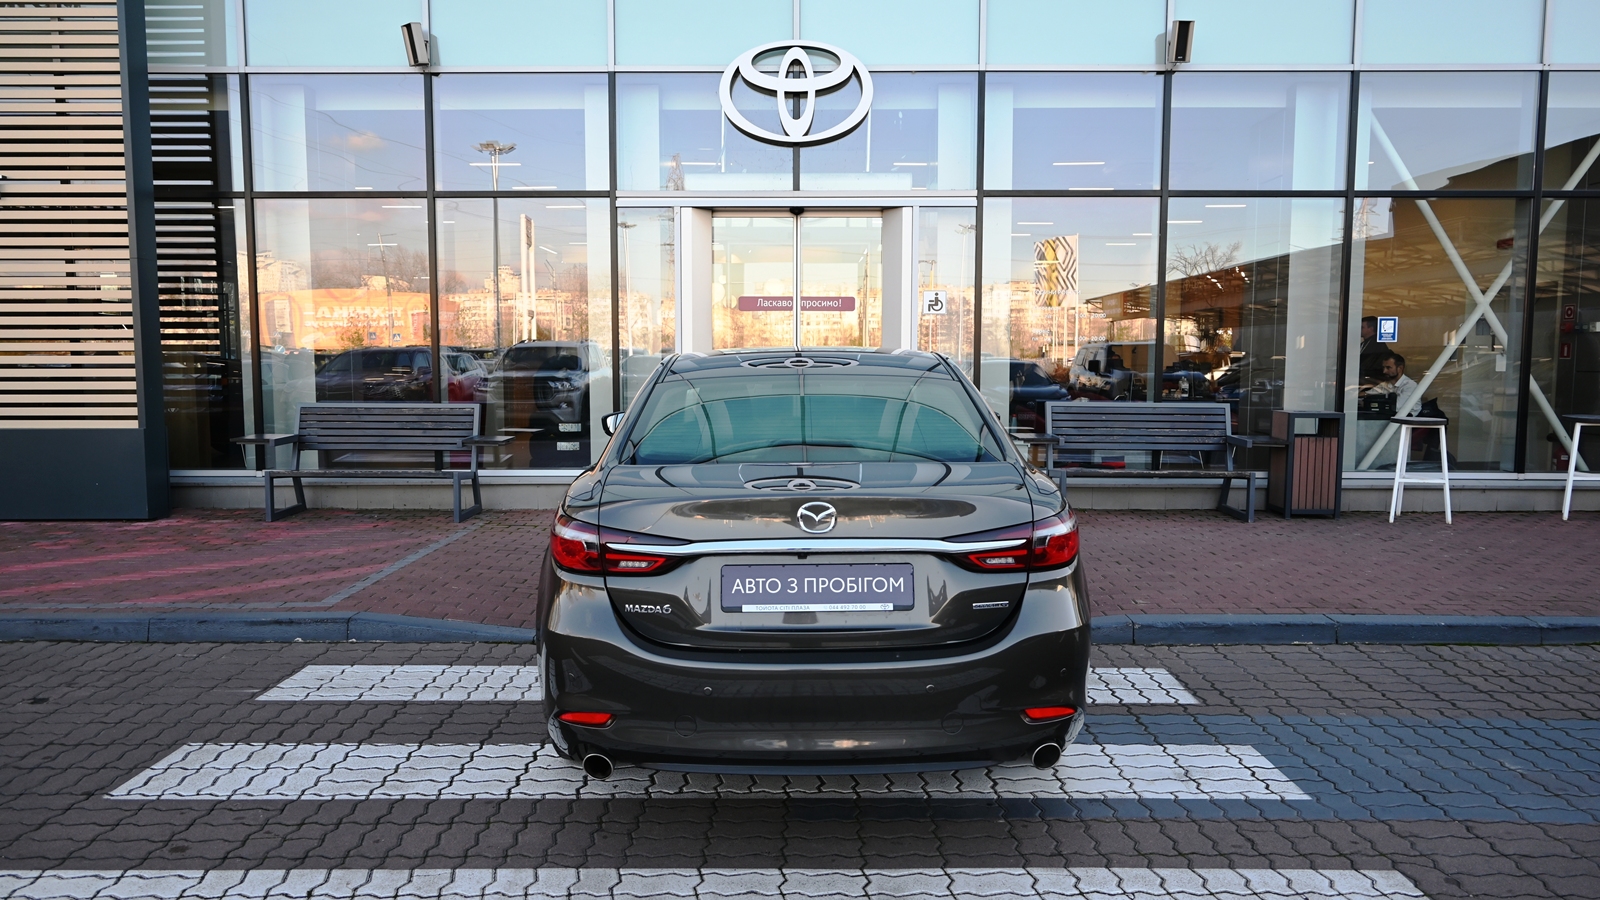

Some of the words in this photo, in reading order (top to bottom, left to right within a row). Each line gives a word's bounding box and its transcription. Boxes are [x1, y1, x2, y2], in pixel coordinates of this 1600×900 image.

[757, 298, 793, 307] Ласкаво
[801, 298, 842, 309] просимо!
[732, 578, 782, 594] АВТО
[804, 577, 904, 593] ПРОБІГОМ
